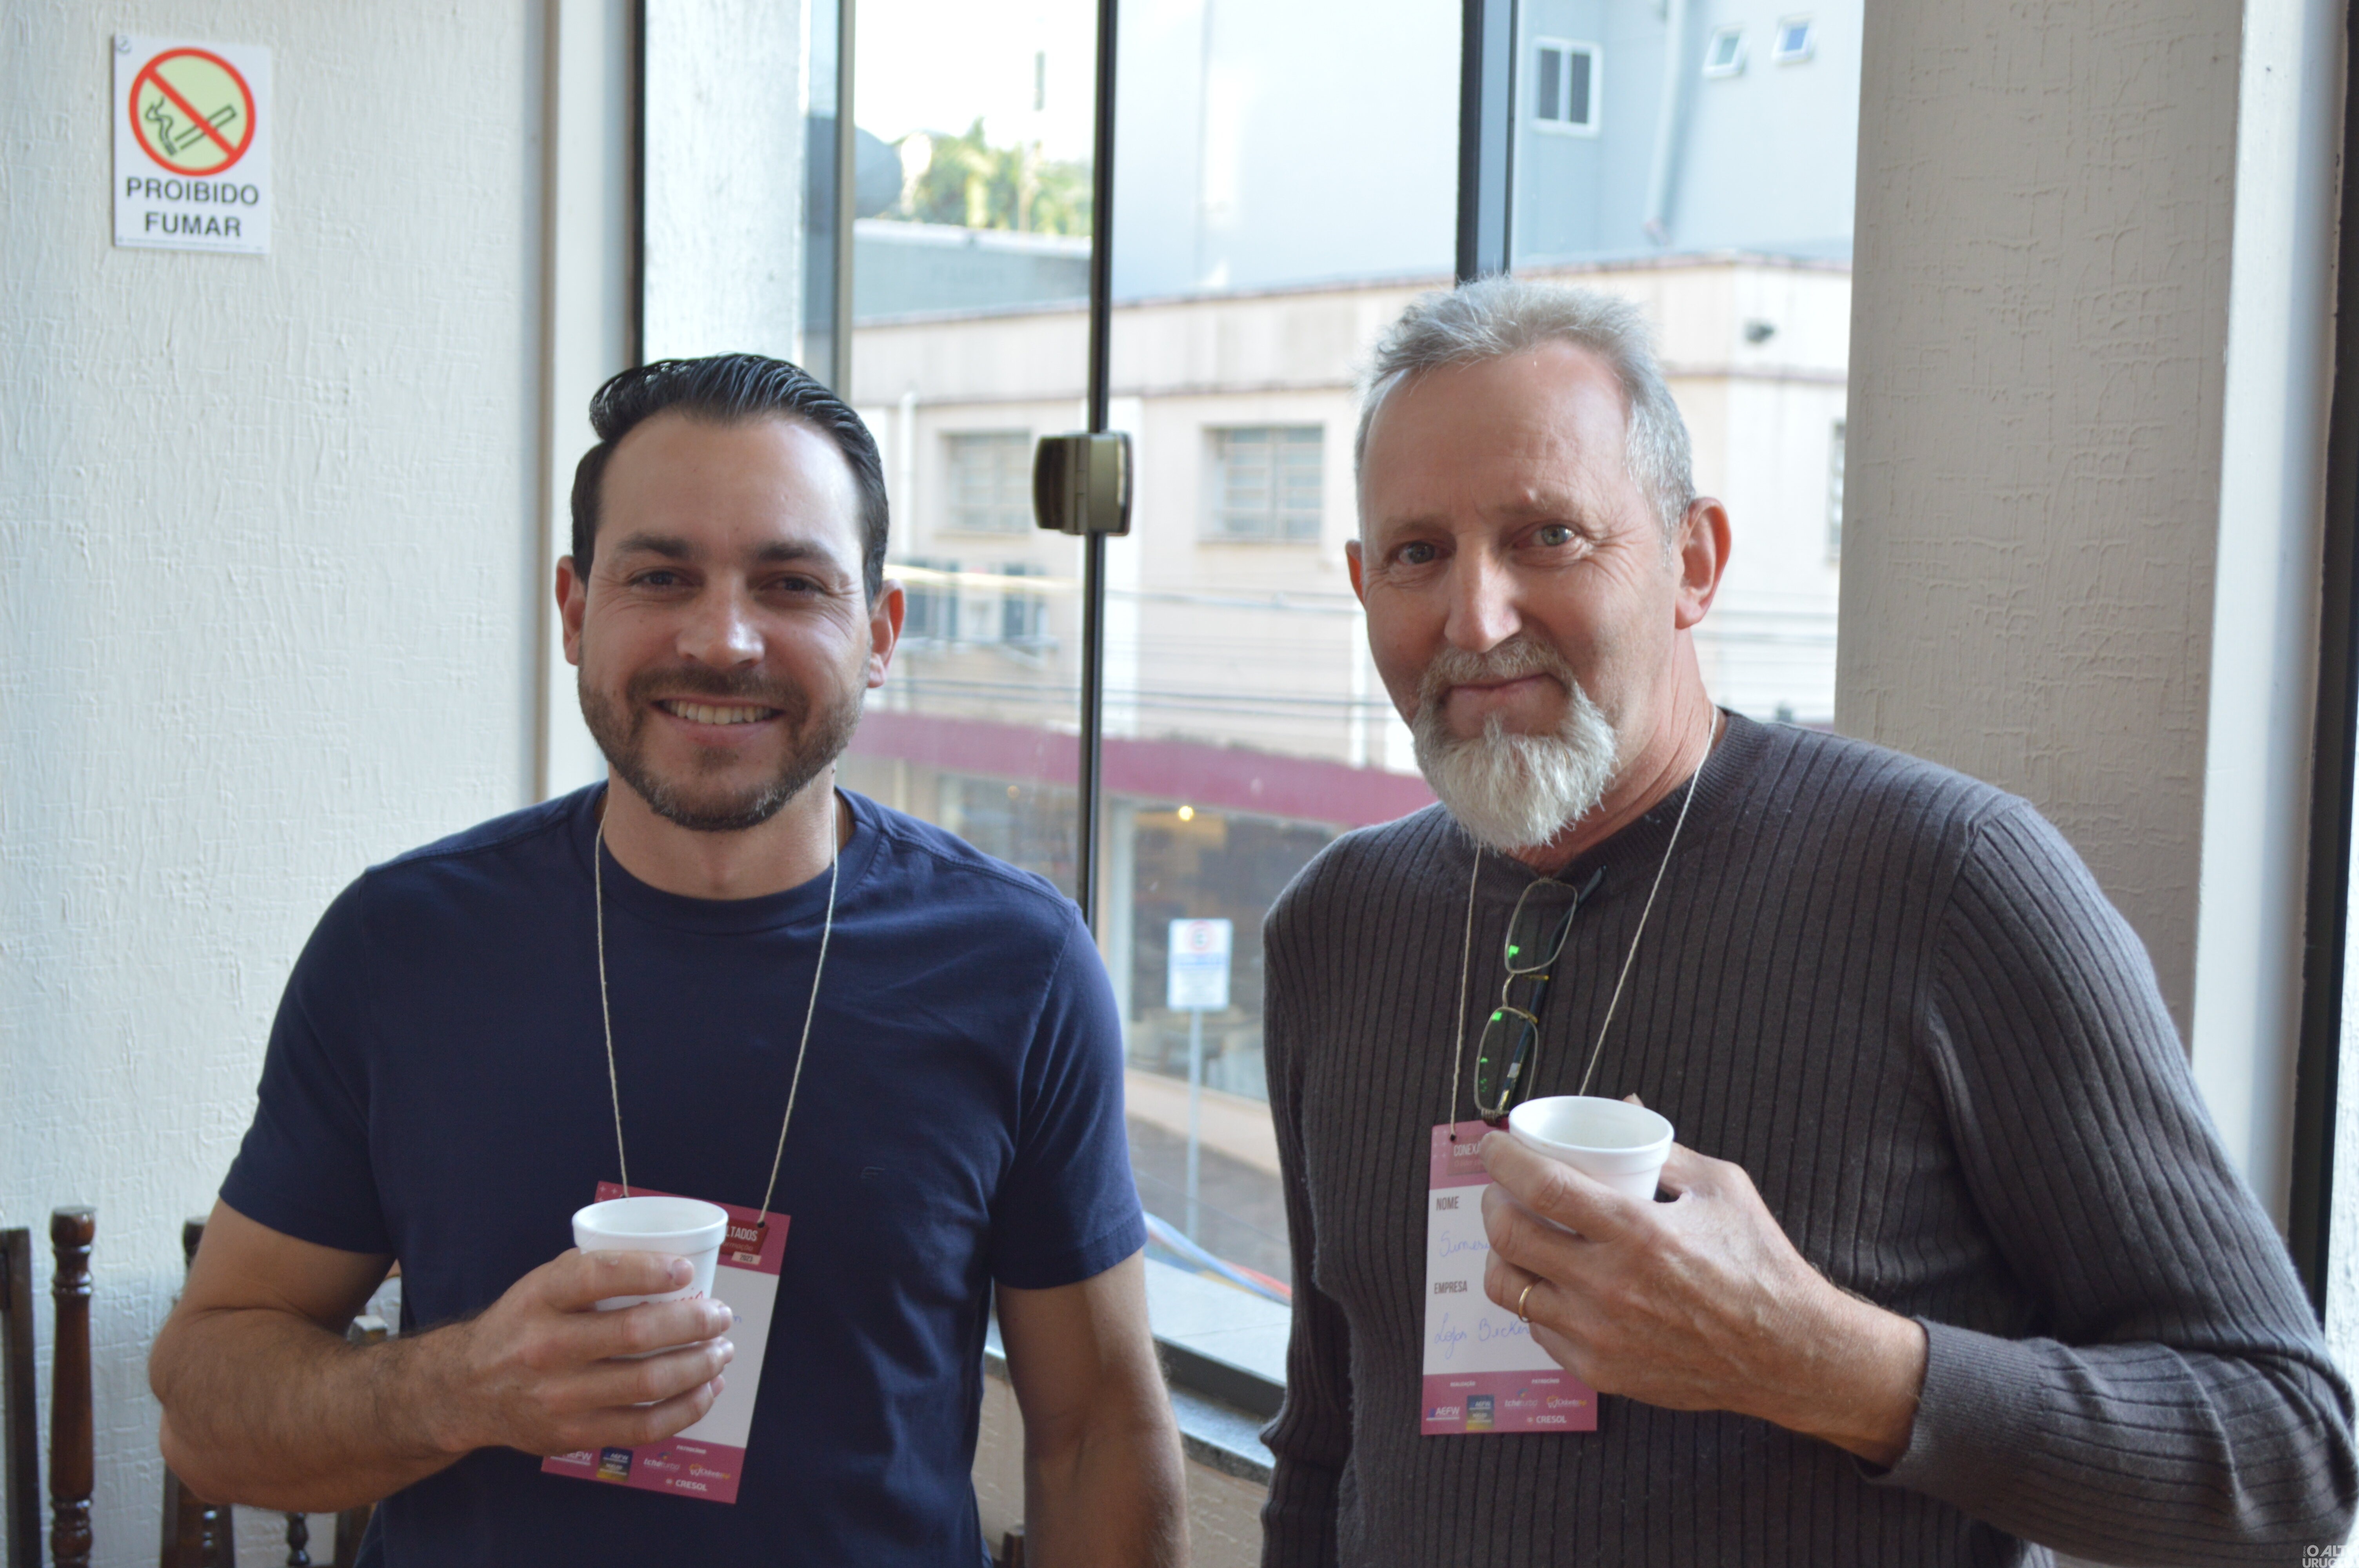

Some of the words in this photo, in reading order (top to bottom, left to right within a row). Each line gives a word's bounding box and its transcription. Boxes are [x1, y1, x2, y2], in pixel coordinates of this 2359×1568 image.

[127, 177, 259, 206] PROIBIDO
[145, 212, 241, 238] FUMAR
[1436, 1196, 1459, 1210] NOME
[726, 1225, 758, 1242] LTADOS
[1434, 1280, 1467, 1294] EMPRESA
[1435, 1406, 1460, 1416] AEFW
[1536, 1415, 1567, 1424] CRESOL
[675, 1479, 707, 1492] CRESOL
